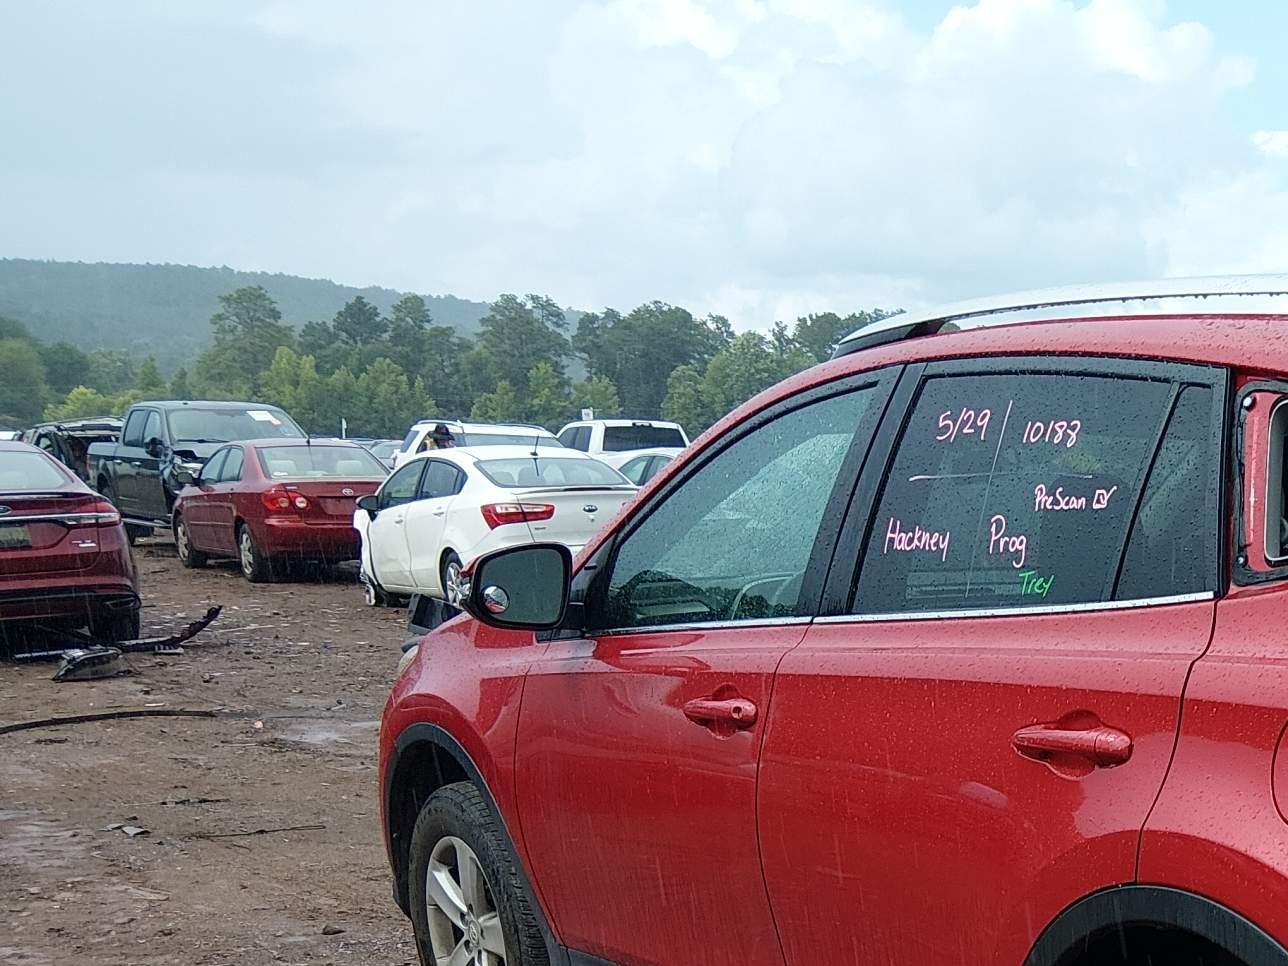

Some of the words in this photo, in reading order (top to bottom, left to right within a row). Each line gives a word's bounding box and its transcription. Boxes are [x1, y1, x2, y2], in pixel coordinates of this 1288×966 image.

[935, 407, 992, 444] 5/29
[883, 516, 951, 563] Hackney
[988, 513, 1028, 569] Prog
[1017, 569, 1056, 598] Trey
